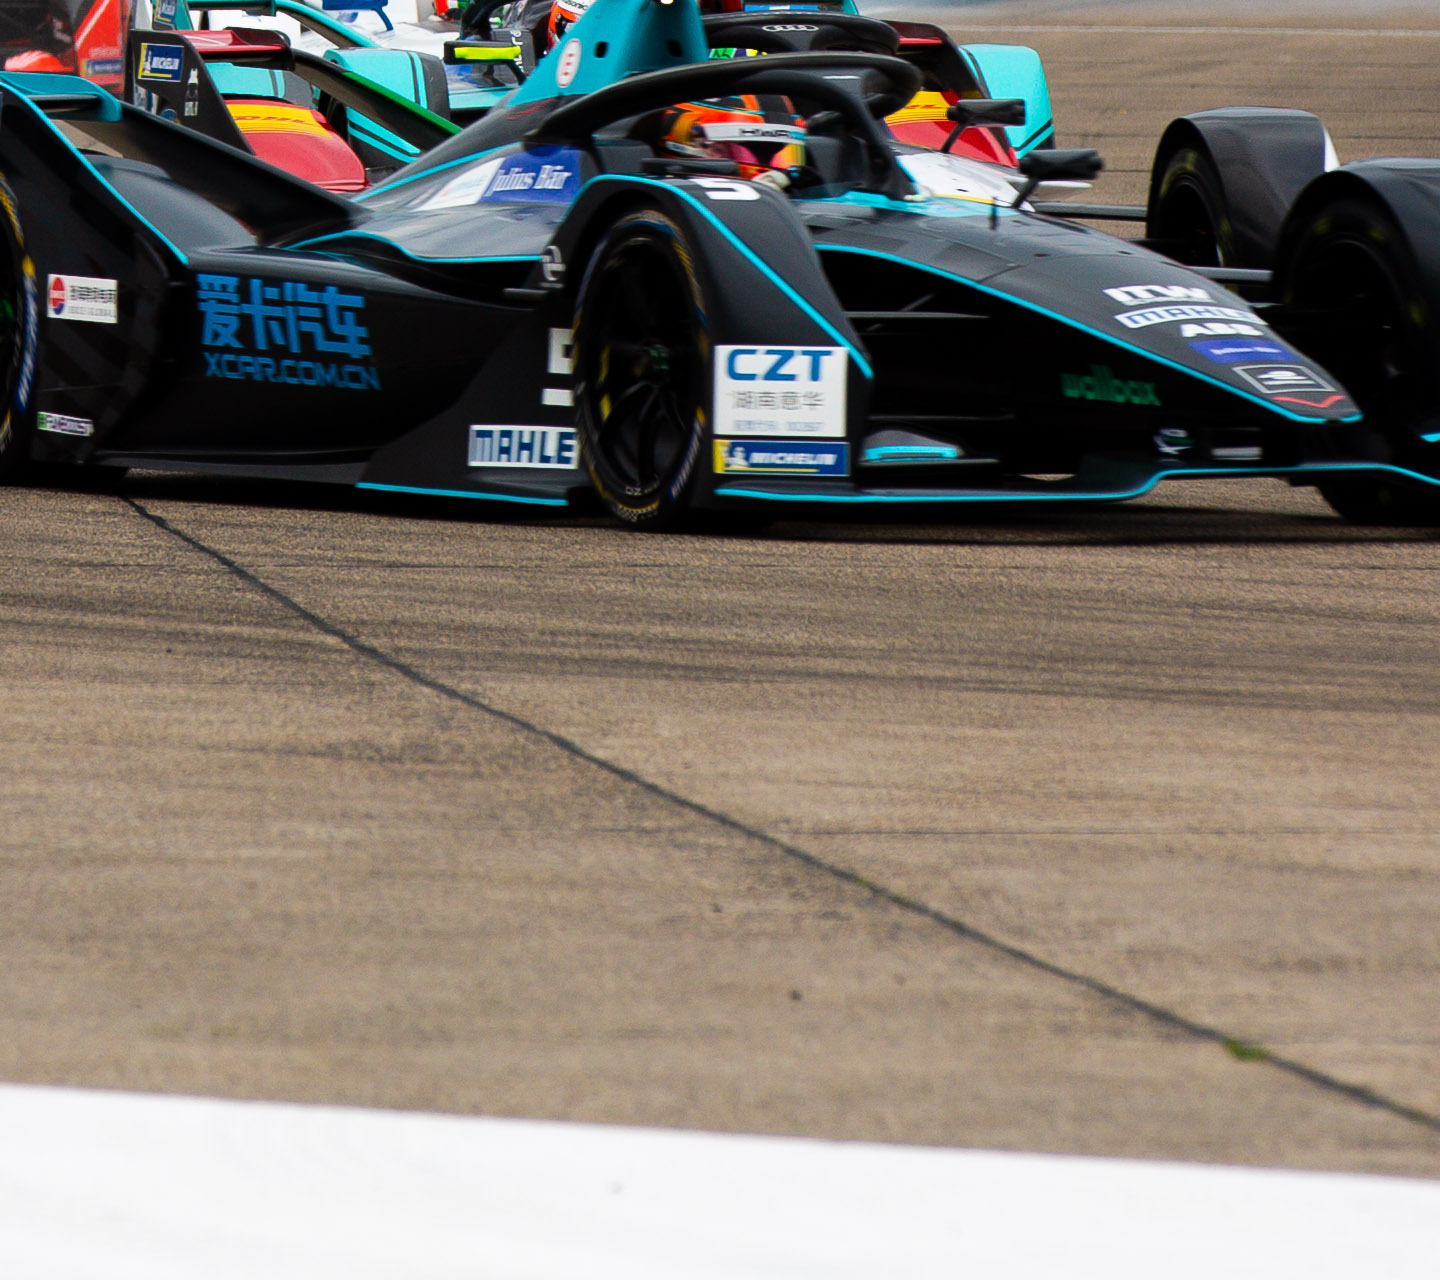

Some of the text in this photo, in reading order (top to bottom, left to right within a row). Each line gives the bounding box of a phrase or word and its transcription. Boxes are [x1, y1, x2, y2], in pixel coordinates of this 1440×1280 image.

[1103, 285, 1211, 302] ITW
[197, 274, 372, 359] 爱卡汽车
[1178, 322, 1265, 338] ABB
[727, 348, 833, 382] CZT
[471, 429, 573, 465] MAHLE
[749, 452, 838, 465] MICHELIN
